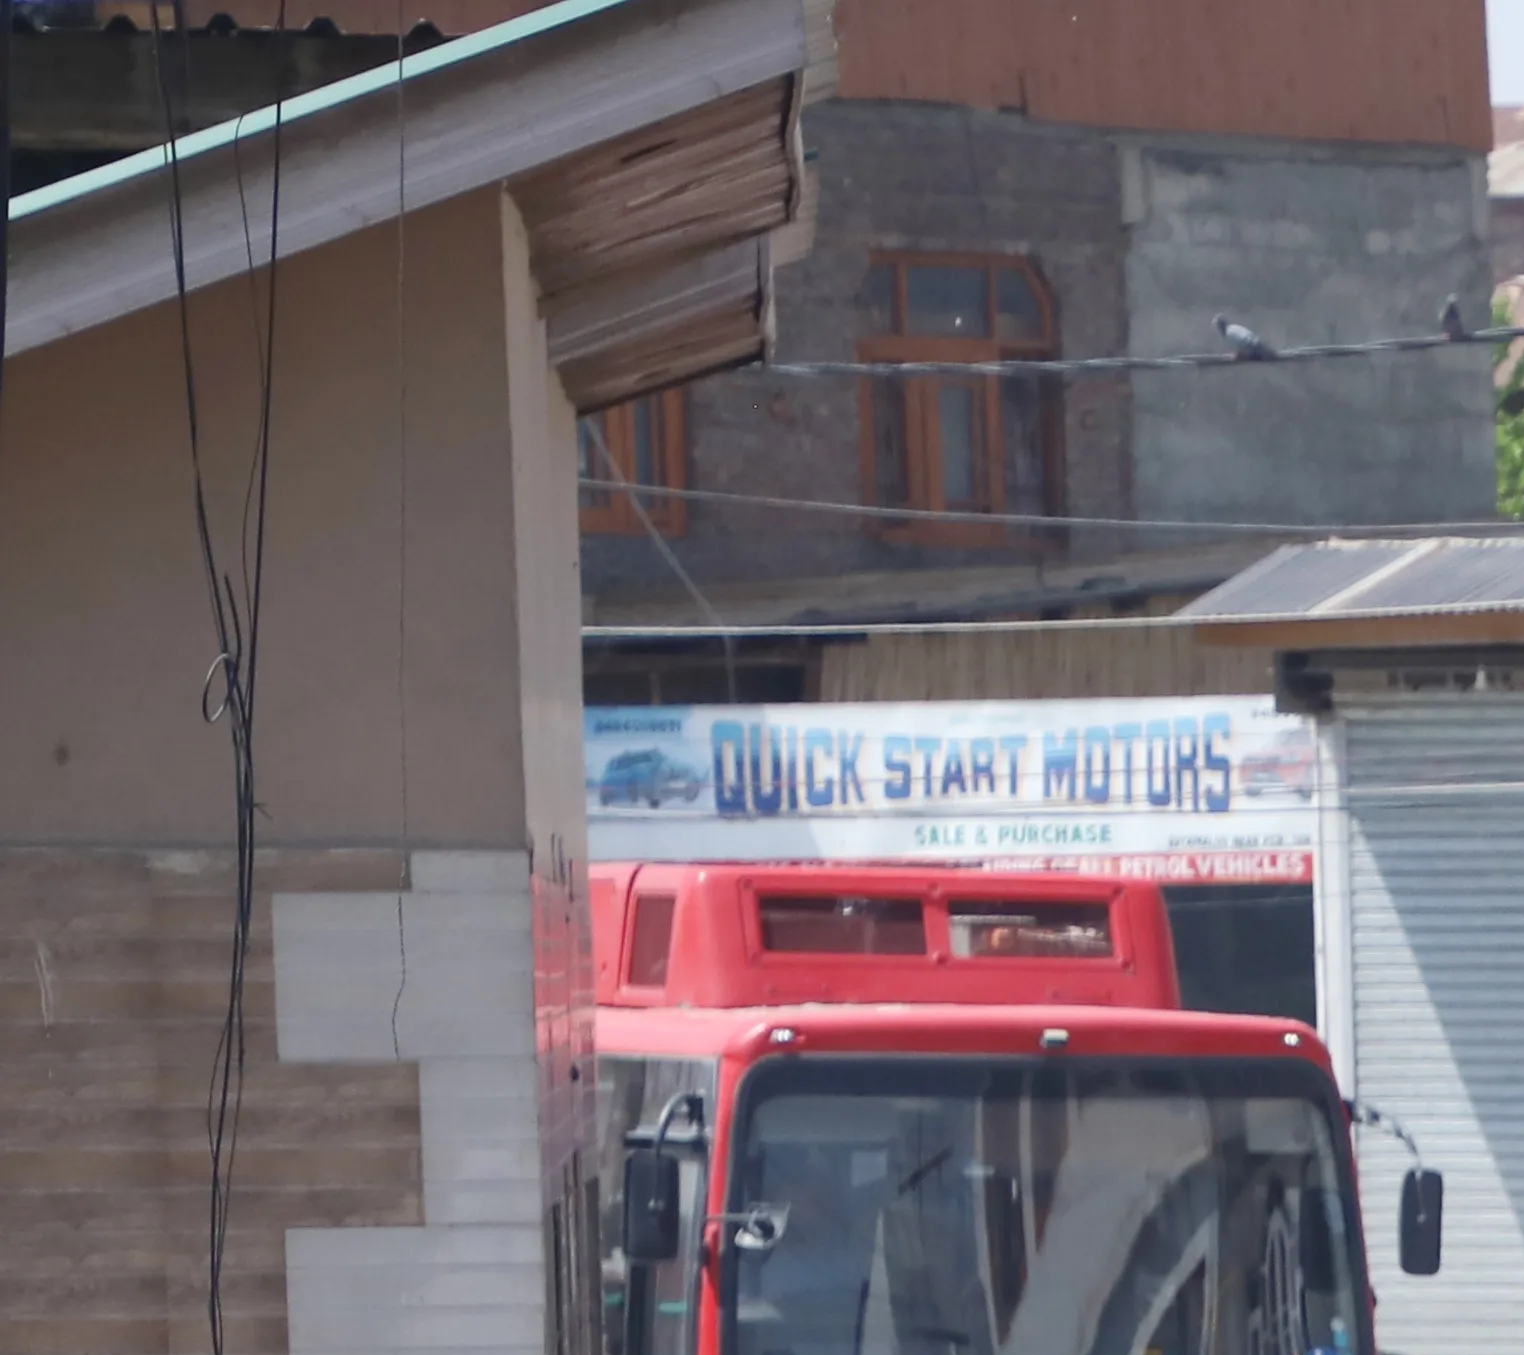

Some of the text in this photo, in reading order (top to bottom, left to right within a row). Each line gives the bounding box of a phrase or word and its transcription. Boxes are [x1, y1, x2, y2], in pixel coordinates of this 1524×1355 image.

[711, 711, 1232, 819] QUICK START MOTORS
[914, 822, 1113, 846] SALE & PURCHASE
[1119, 852, 1196, 879] PETROL
[1197, 849, 1306, 878] VEHICLES
